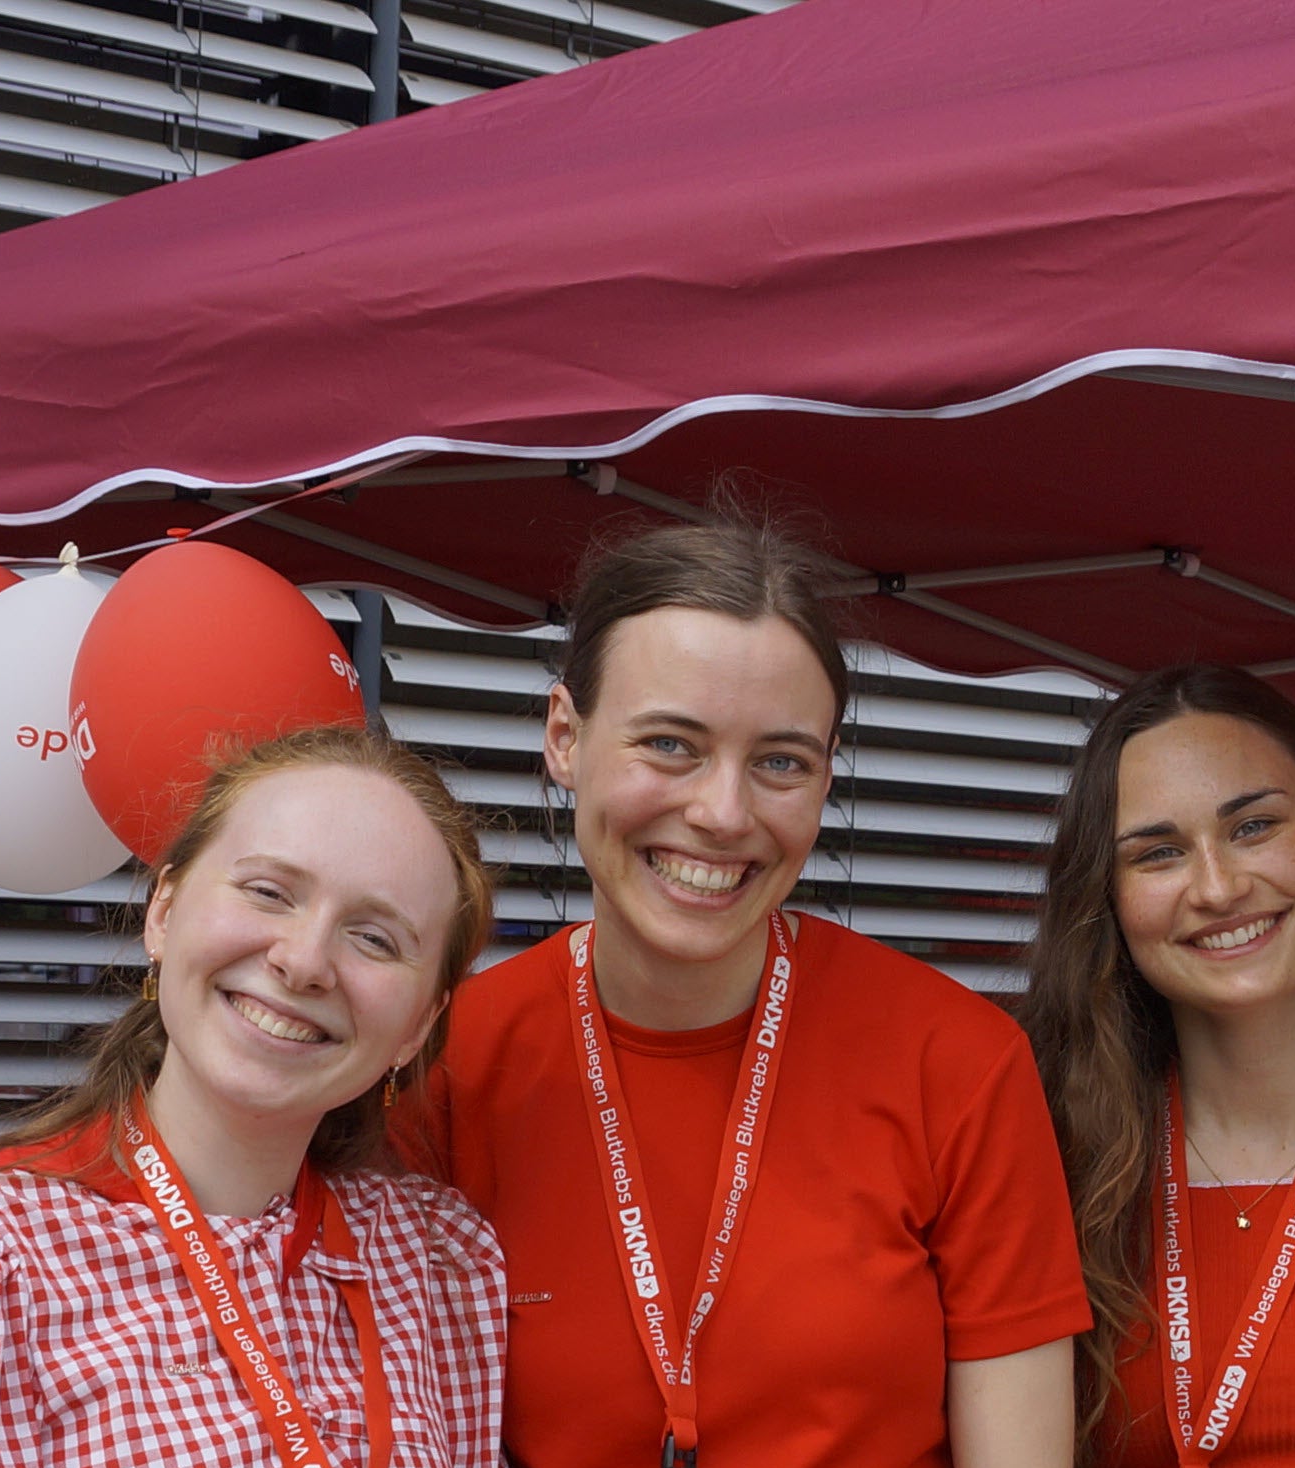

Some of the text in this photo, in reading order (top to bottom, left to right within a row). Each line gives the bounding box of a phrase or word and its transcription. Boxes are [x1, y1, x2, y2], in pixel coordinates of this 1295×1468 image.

[581, 1012, 608, 1105] besiegen
[600, 1107, 633, 1204] Blutkrebs
[619, 1206, 654, 1277] DKMS
[706, 977, 788, 1284] Wir besiegen Blutkrebs DKMS
[143, 1160, 311, 1464] Wir besiegen Blutkrebs DKMS
[644, 1302, 678, 1387] dkms.de
[679, 1312, 705, 1386] DKMS
[1166, 1276, 1190, 1342] DKMS
[1234, 1323, 1260, 1359] Wir
[1248, 1248, 1293, 1327] besiegen
[1198, 1386, 1238, 1451] DKMS
